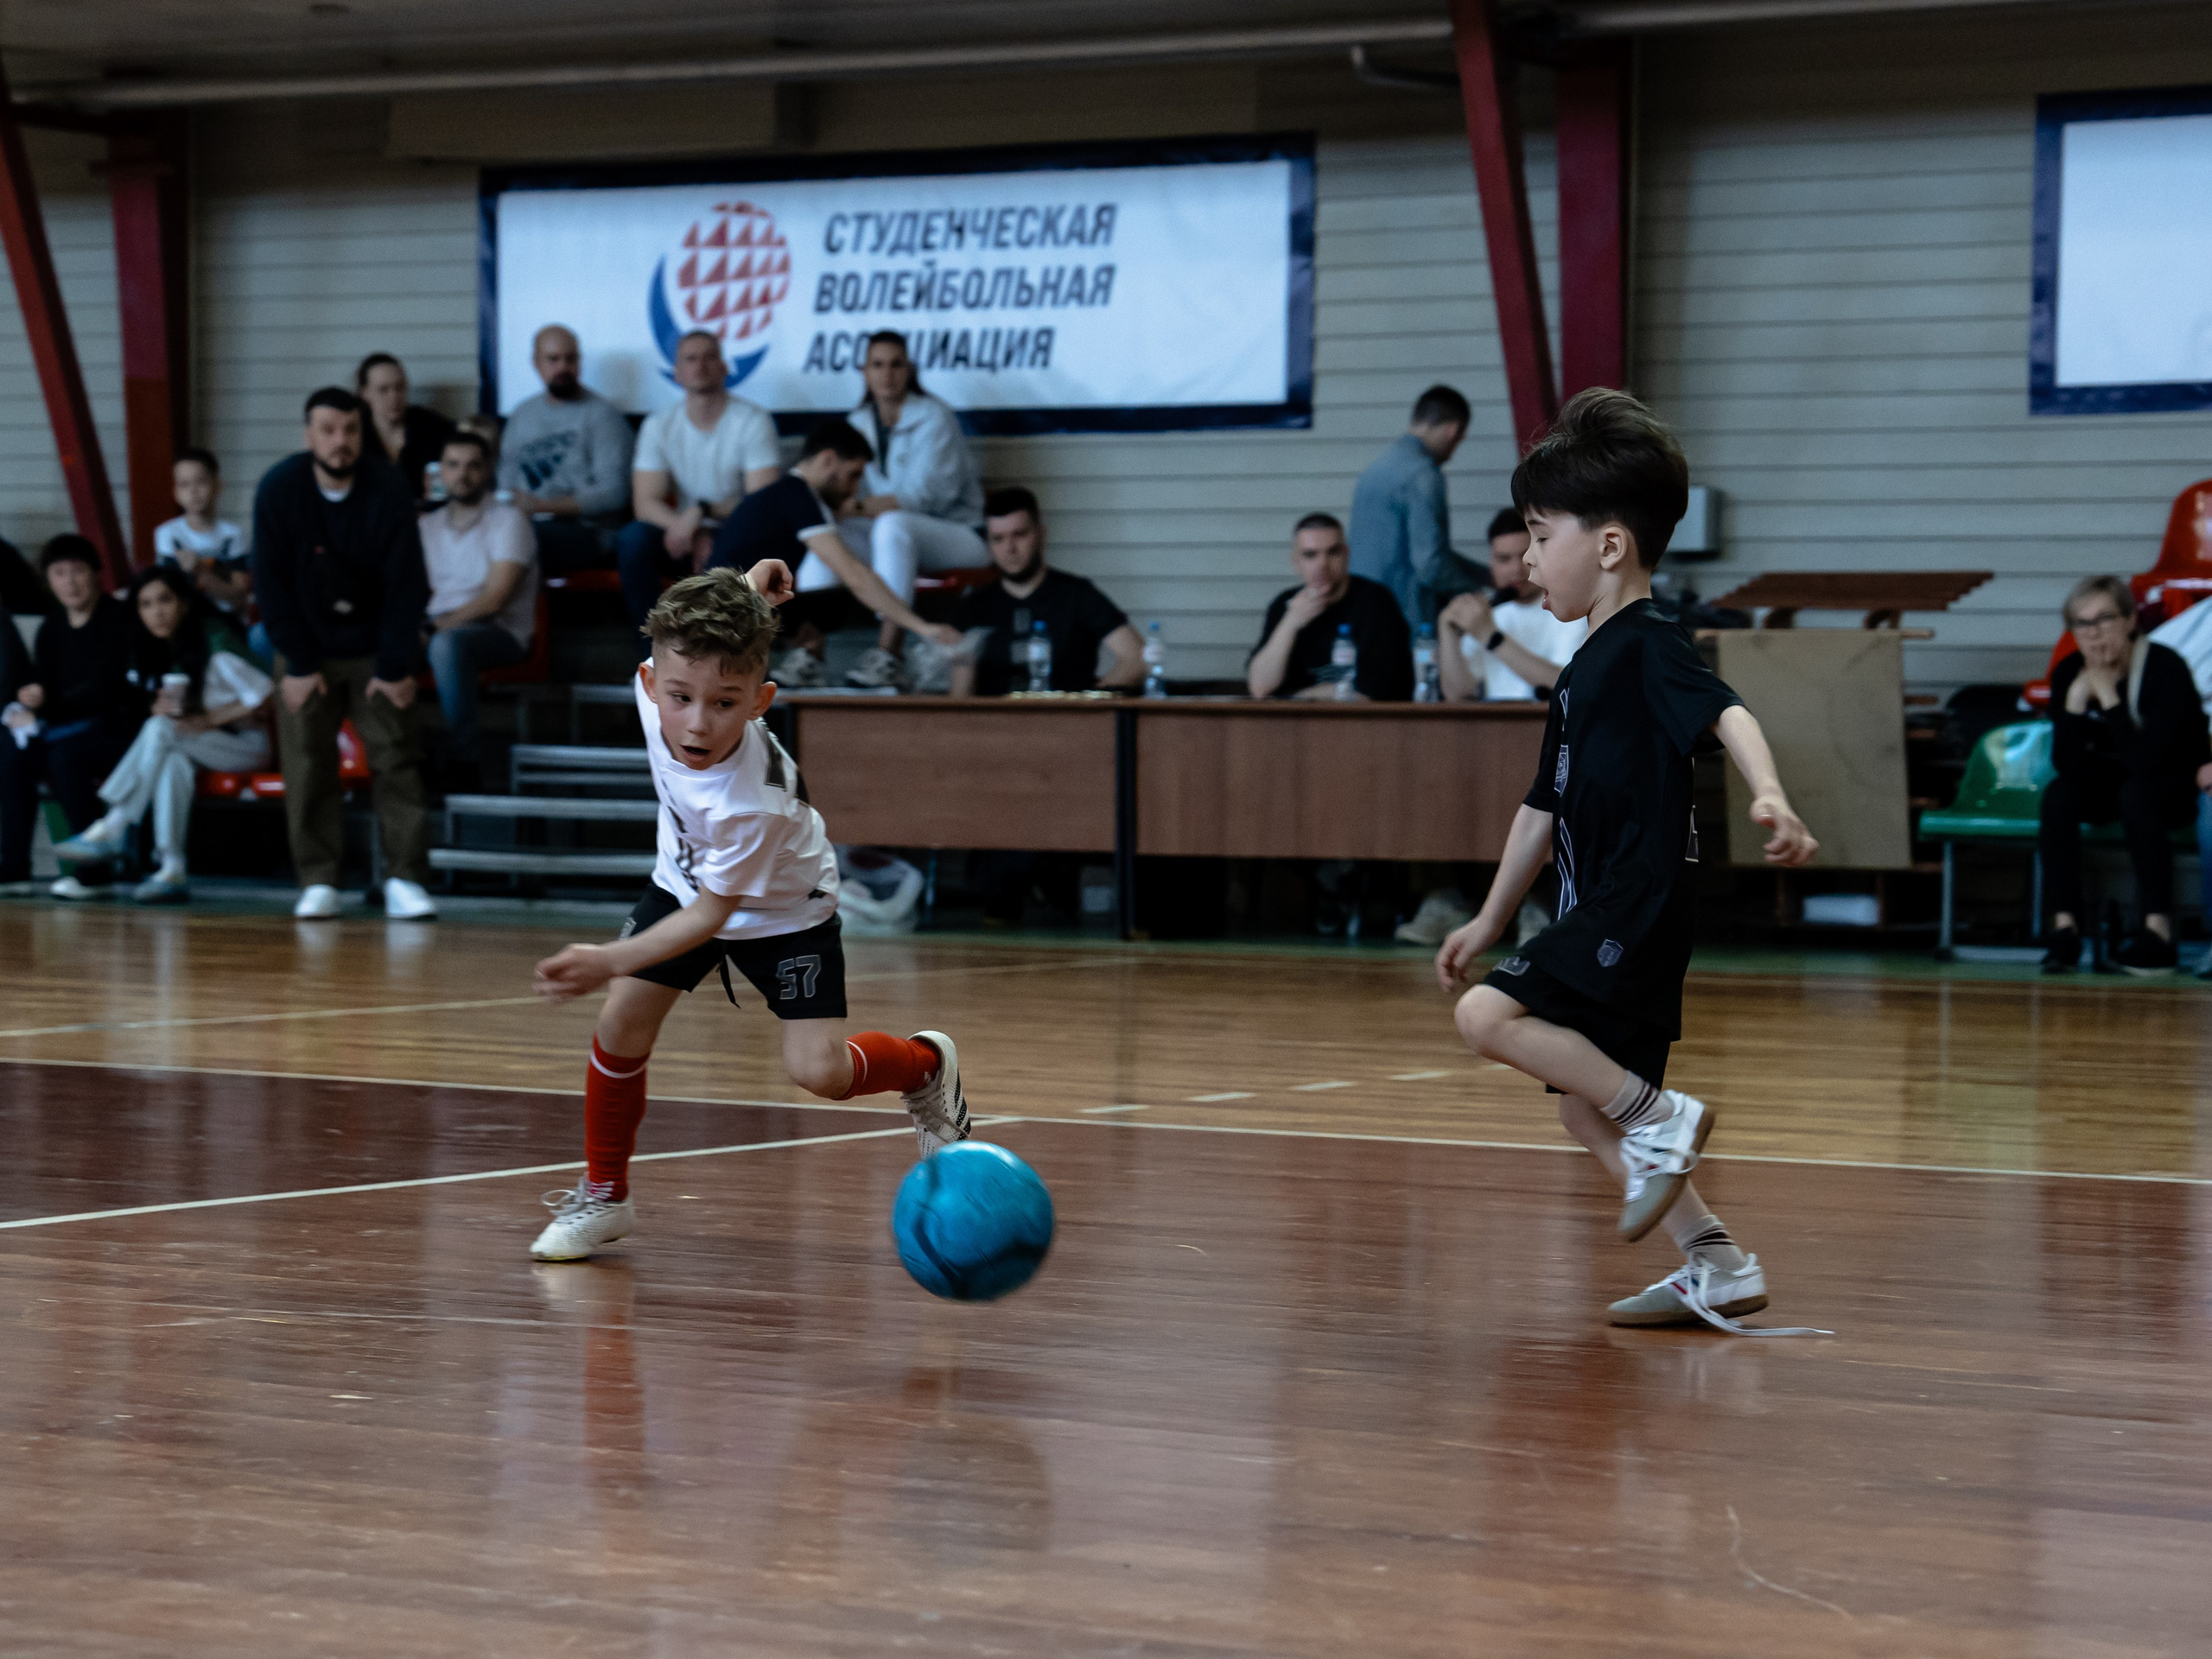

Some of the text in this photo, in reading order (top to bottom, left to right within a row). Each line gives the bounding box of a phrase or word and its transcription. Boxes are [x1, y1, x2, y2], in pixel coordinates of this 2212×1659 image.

[825, 202, 1117, 256] СТУДЕНЧЕСКАЯ
[815, 259, 1116, 313] ВОЛЕЙБОЛЬНАЯ
[776, 954, 822, 1000] 57
